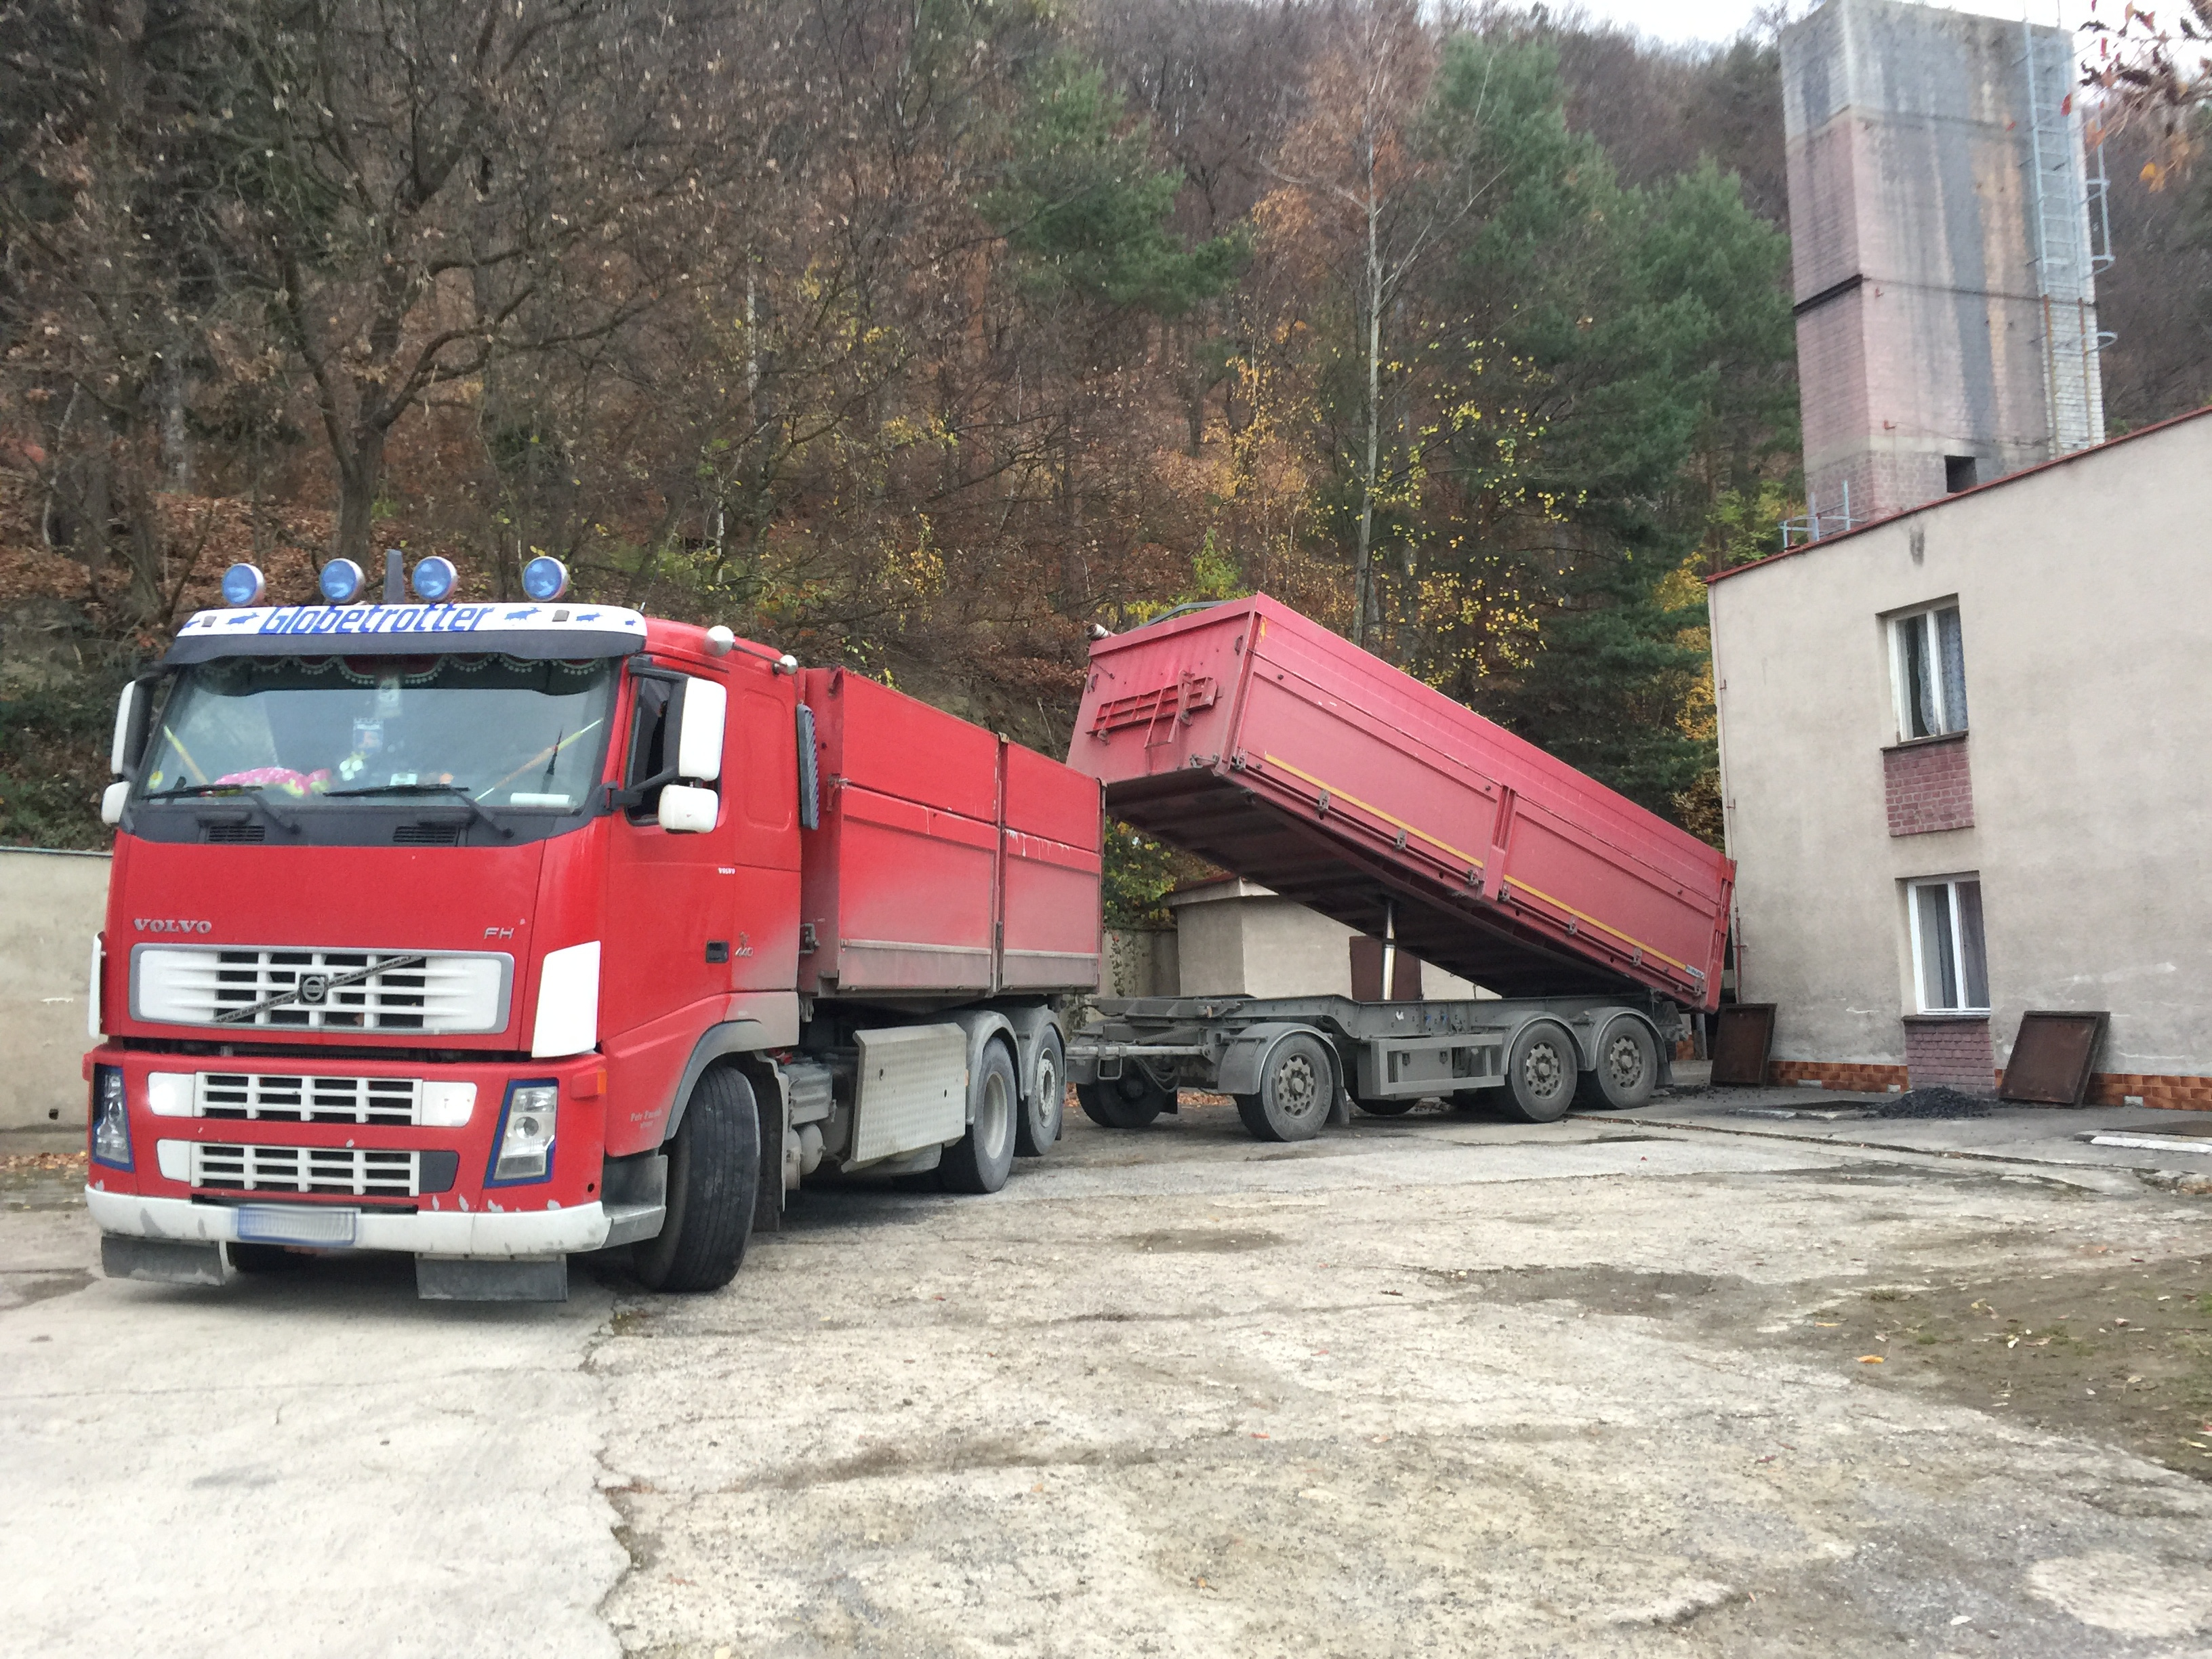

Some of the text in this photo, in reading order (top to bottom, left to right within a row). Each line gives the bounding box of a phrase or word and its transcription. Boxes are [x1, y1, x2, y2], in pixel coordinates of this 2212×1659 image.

[258, 603, 495, 634] Globetrotter
[718, 867, 735, 875] VOLVO
[134, 918, 212, 935] VOLVO
[483, 927, 514, 939] FH
